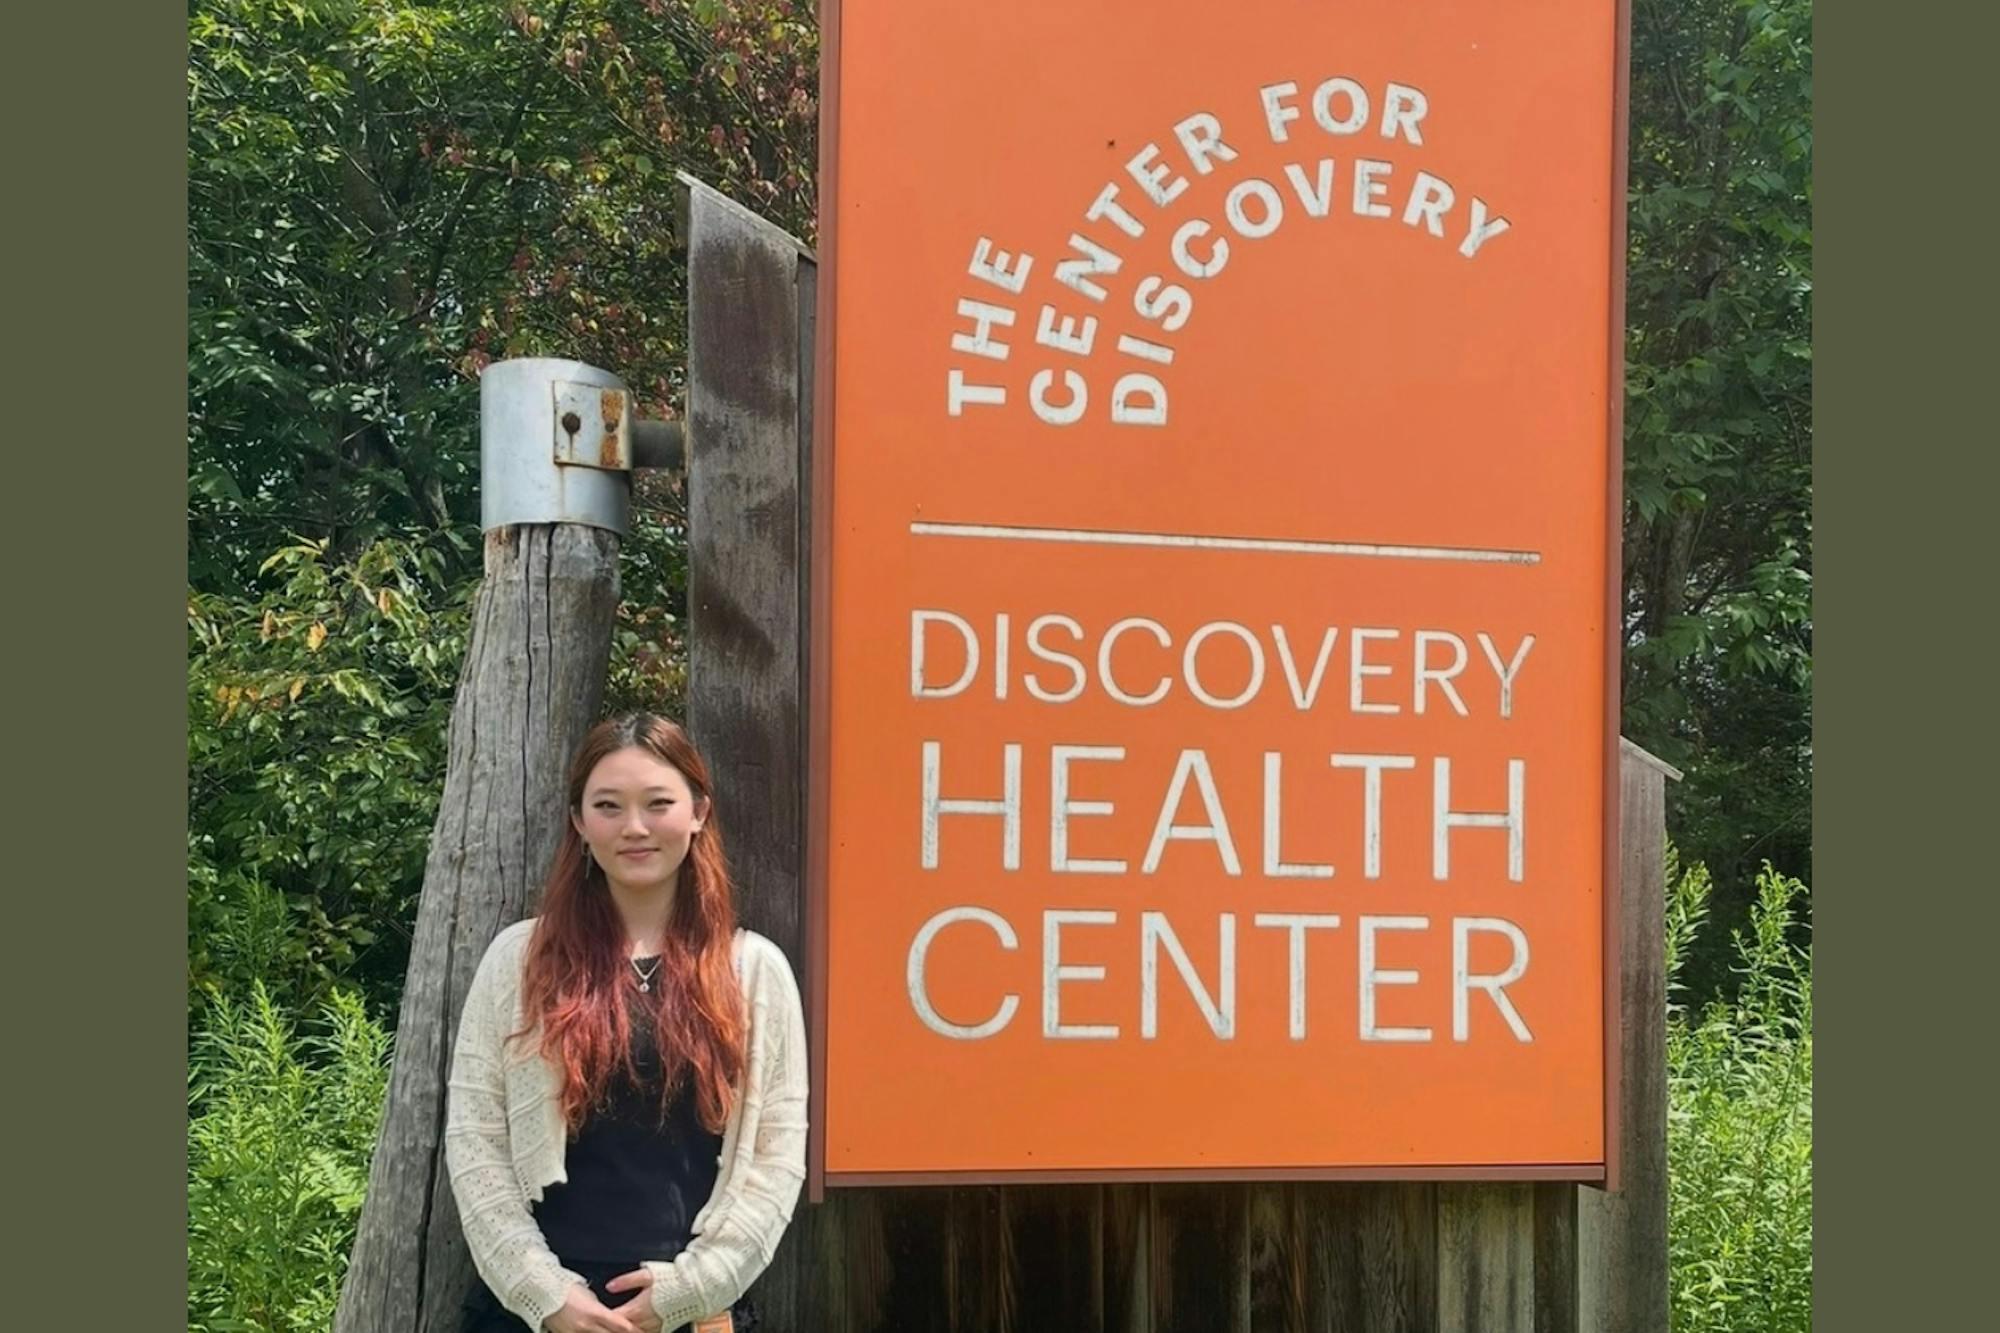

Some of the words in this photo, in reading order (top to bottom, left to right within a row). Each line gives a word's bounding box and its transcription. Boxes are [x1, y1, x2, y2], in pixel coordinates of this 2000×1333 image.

[948, 236, 1034, 416] THE
[1028, 112, 1238, 426] CENTER
[1259, 76, 1429, 146] FOR
[1110, 158, 1511, 426] DISCOVERY
[910, 609, 1536, 718] DISCOVERY
[921, 740, 1526, 882] HEALTH
[906, 906, 1533, 1042] CENTER
